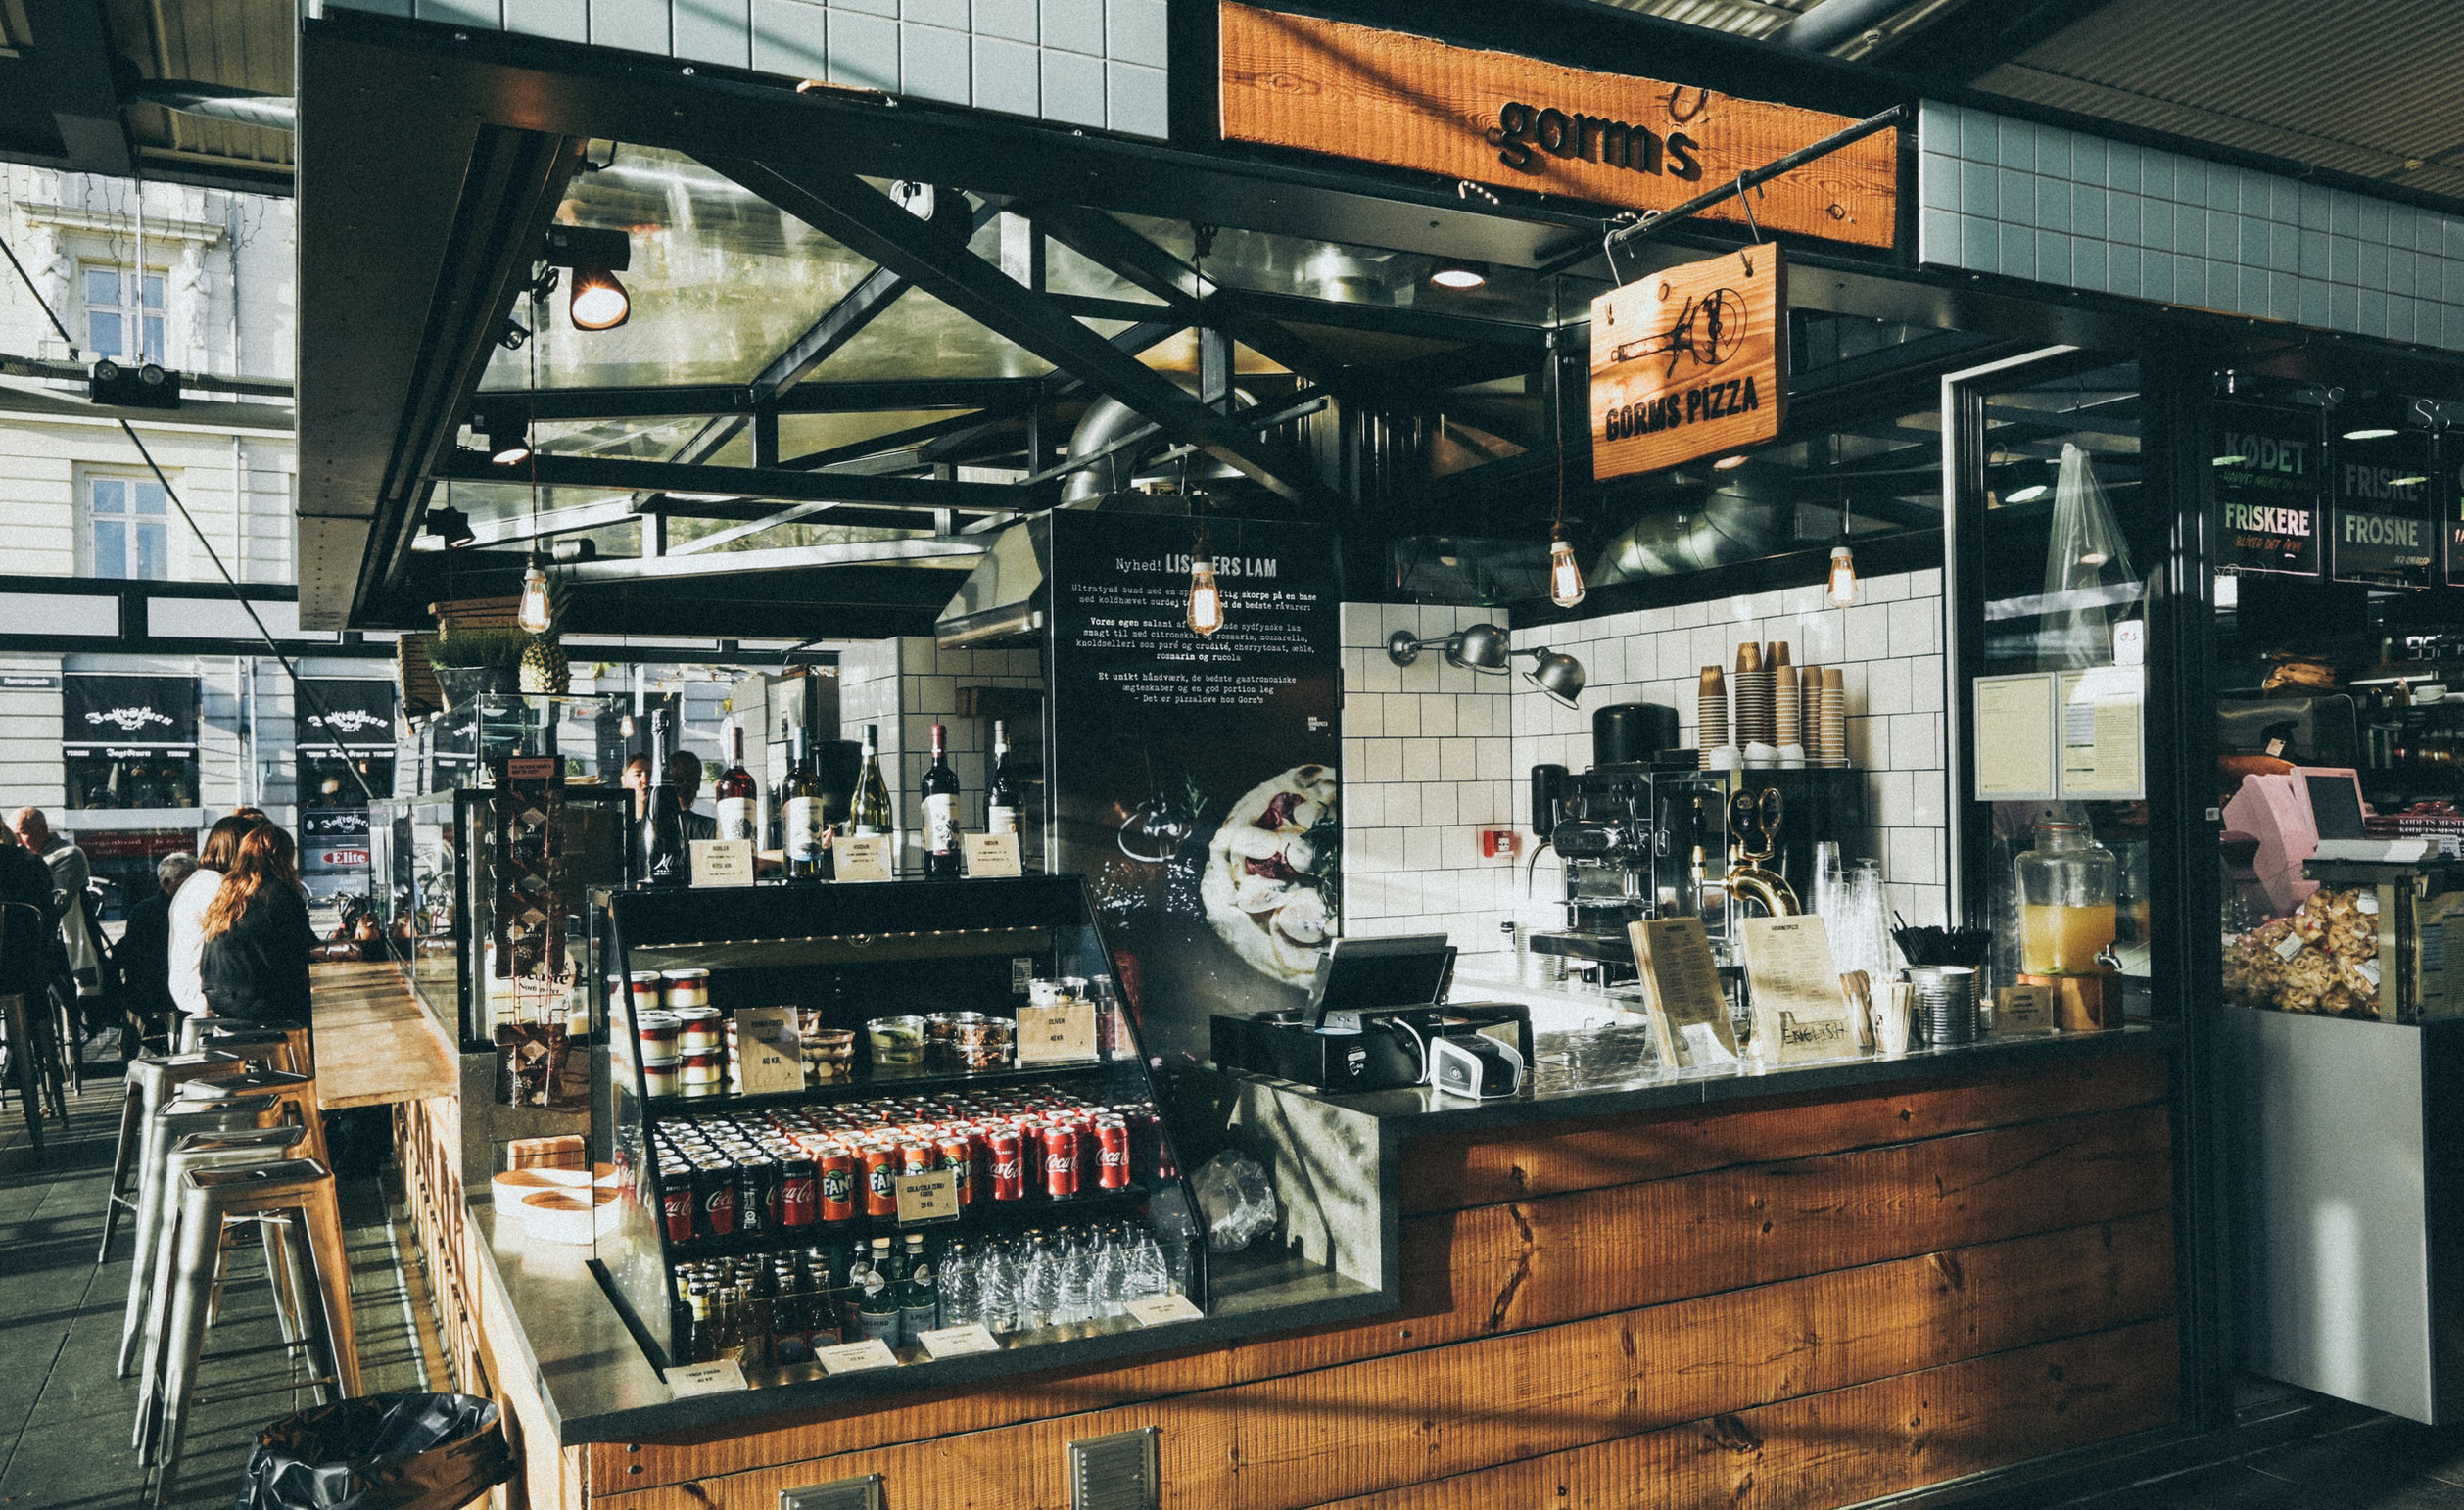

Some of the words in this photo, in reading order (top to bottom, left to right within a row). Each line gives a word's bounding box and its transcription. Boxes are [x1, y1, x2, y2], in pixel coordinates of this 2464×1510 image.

[1606, 394, 1682, 442] GORMS
[1687, 376, 1759, 425] PIZZA
[2224, 432, 2308, 475] KØDET
[2225, 502, 2310, 537] FRISKERE
[2346, 514, 2419, 547] FROSNE
[1115, 557, 1161, 573] Nyhed!
[1245, 557, 1277, 577] LAM
[1071, 584, 1118, 594] Ultratynd
[1123, 586, 1143, 594] bund
[1098, 595, 1147, 605] koldhævet
[1150, 598, 1179, 607] surdej
[1242, 590, 1269, 600] skorpe
[1273, 590, 1283, 601] på
[1245, 601, 1272, 610] bedste
[1090, 616, 1115, 626] Vores
[1118, 619, 1139, 628] egen
[1142, 619, 1172, 628] salami
[1242, 623, 1283, 632] sydfynske
[1083, 629, 1110, 638] smagt
[1151, 631, 1200, 639] citronskal
[1076, 638, 1136, 648] knoldselleri
[1159, 640, 1179, 650] puré
[1199, 653, 1208, 662] og
[1212, 653, 1241, 662] rucola
[1098, 672, 1109, 681] Et
[1113, 672, 1139, 681] unikt
[1142, 671, 1189, 683] håndværk,
[1205, 674, 1232, 683] bedste
[1236, 675, 1297, 684] gastronomiske
[1122, 684, 1174, 693] ægteskaber
[1177, 684, 1188, 694] og
[1205, 685, 1219, 694] god
[1223, 685, 1256, 694] portion
[1259, 685, 1274, 695] leg
[1143, 694, 1158, 703] Det
[1174, 695, 1217, 704] pizzalove
[333, 851, 366, 863] Elite
[1782, 1021, 1844, 1045] ENGLISH
[762, 1057, 771, 1065] 40
[823, 1175, 854, 1195] FANT
[869, 1171, 895, 1190] FAN
